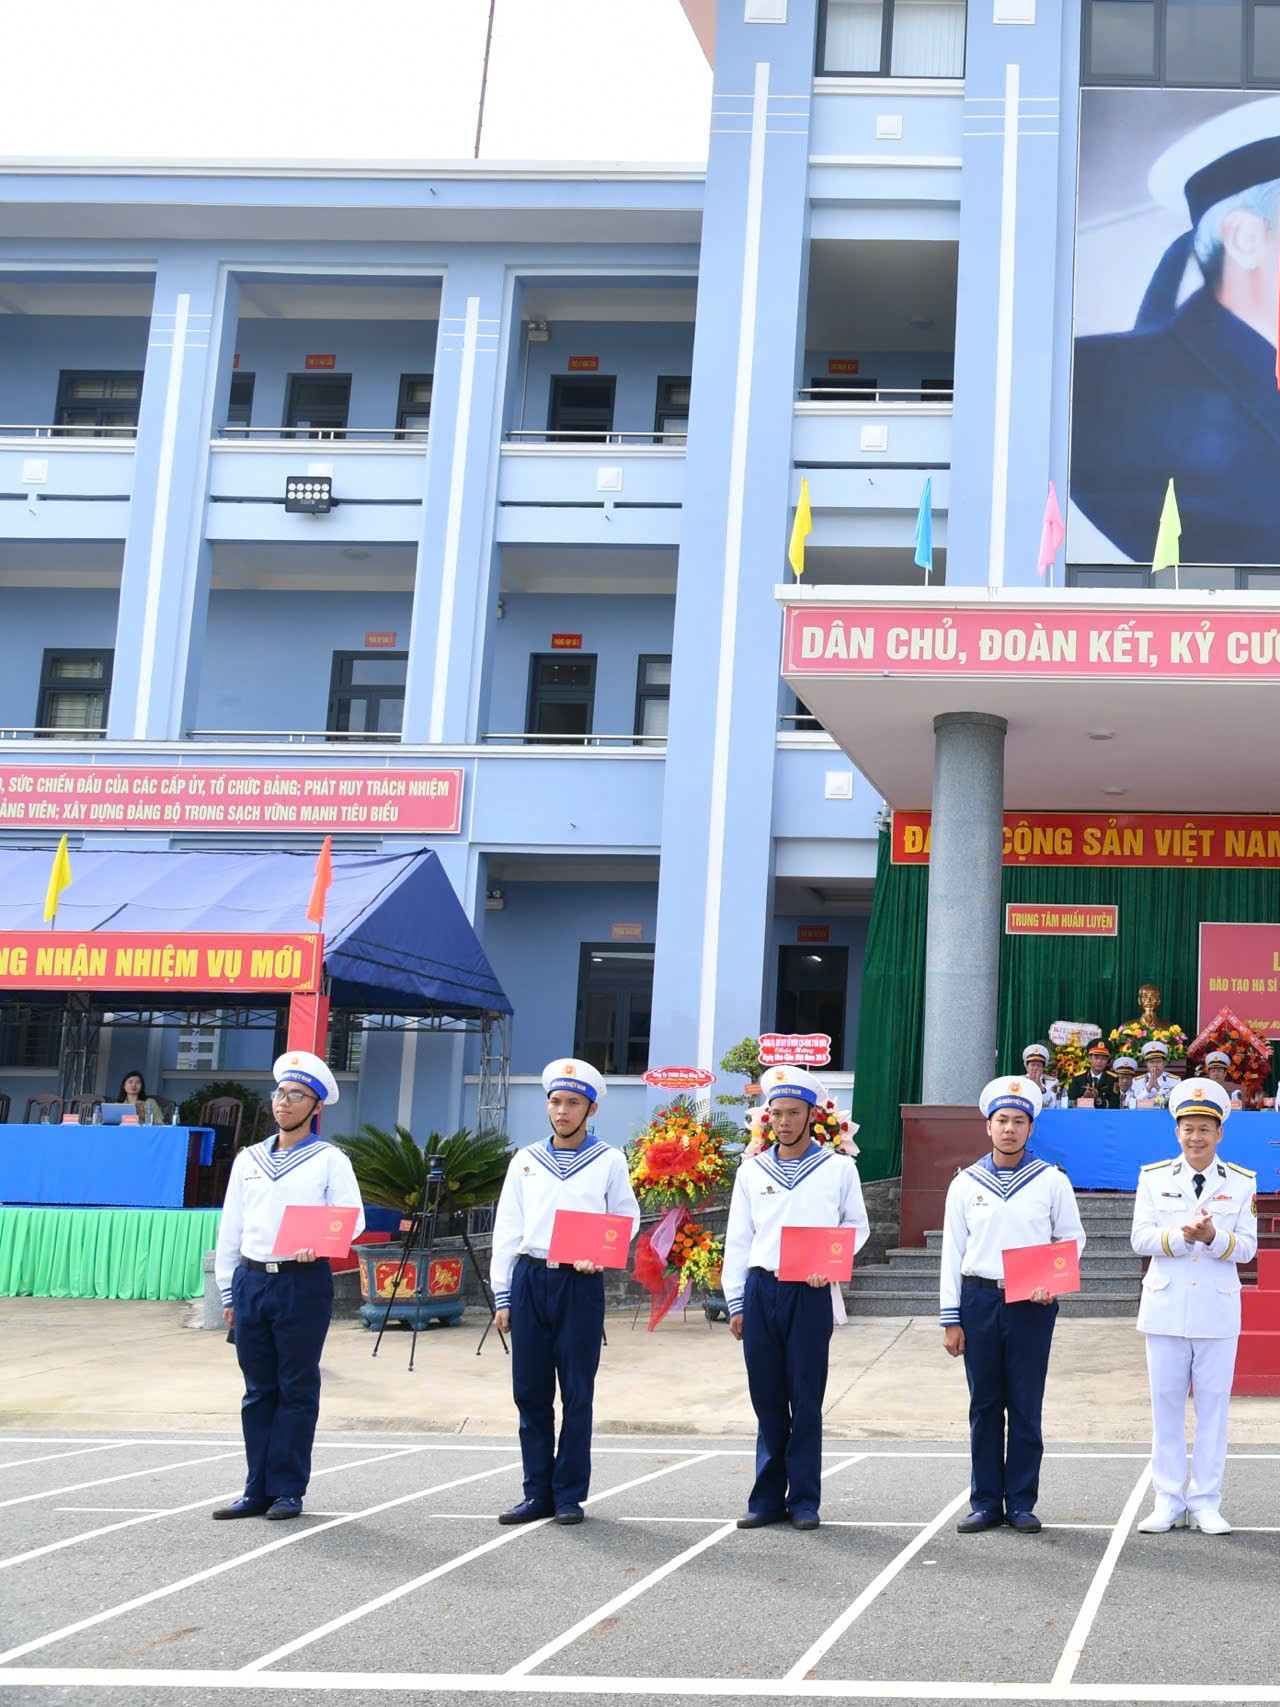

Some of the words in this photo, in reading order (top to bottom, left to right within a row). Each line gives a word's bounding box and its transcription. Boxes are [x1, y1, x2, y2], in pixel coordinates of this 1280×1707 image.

[801, 620, 873, 659] DÂN
[887, 617, 967, 665] CHỦ,
[979, 622, 1077, 663] ĐOÀN
[1089, 620, 1158, 667] KẾT,
[1170, 619, 1215, 664] KỶ
[8, 774, 34, 793] SỨC
[36, 773, 74, 794] CHIẾN
[76, 773, 102, 794] ĐẤU
[104, 773, 130, 794] CỦA
[132, 775, 158, 795] CÁC
[160, 773, 186, 795] CẤP
[209, 773, 226, 795] TỔ
[227, 776, 261, 796] CHỨC
[263, 774, 302, 797] ĐẢNG;
[304, 777, 336, 796] PHÁT
[338, 780, 363, 796] HUY
[366, 777, 406, 797] TRÁCH
[408, 778, 450, 800] NHIỆM
[28, 799, 60, 821] VIÊN;
[62, 800, 87, 819] XÂY
[89, 801, 124, 823] DỰNG
[126, 800, 161, 821] ĐẢNG
[164, 802, 182, 824] BỘ
[184, 804, 224, 821] TRONG
[227, 805, 261, 824] SẠCH
[263, 803, 297, 822] VỮNG
[300, 806, 338, 825] MẠNH
[341, 803, 367, 822] TIÊU
[370, 800, 399, 822] BIỂU
[1002, 820, 1073, 861] CỘNG
[1082, 818, 1145, 857] SẢN
[1155, 823, 1215, 863] VIỆT
[1011, 912, 1039, 928] TRUNG
[1041, 911, 1060, 928] TÂM
[1061, 909, 1085, 929] HUẤN
[1086, 912, 1113, 931] LUYỆN
[35, 943, 107, 981] NHẬN
[114, 944, 199, 983] NHIỆM
[207, 949, 243, 983] VỤ
[250, 945, 302, 979] MỚI
[1209, 976, 1229, 992] ĐÀO
[1231, 978, 1250, 994] TẠO
[1252, 978, 1265, 994] HẠ
